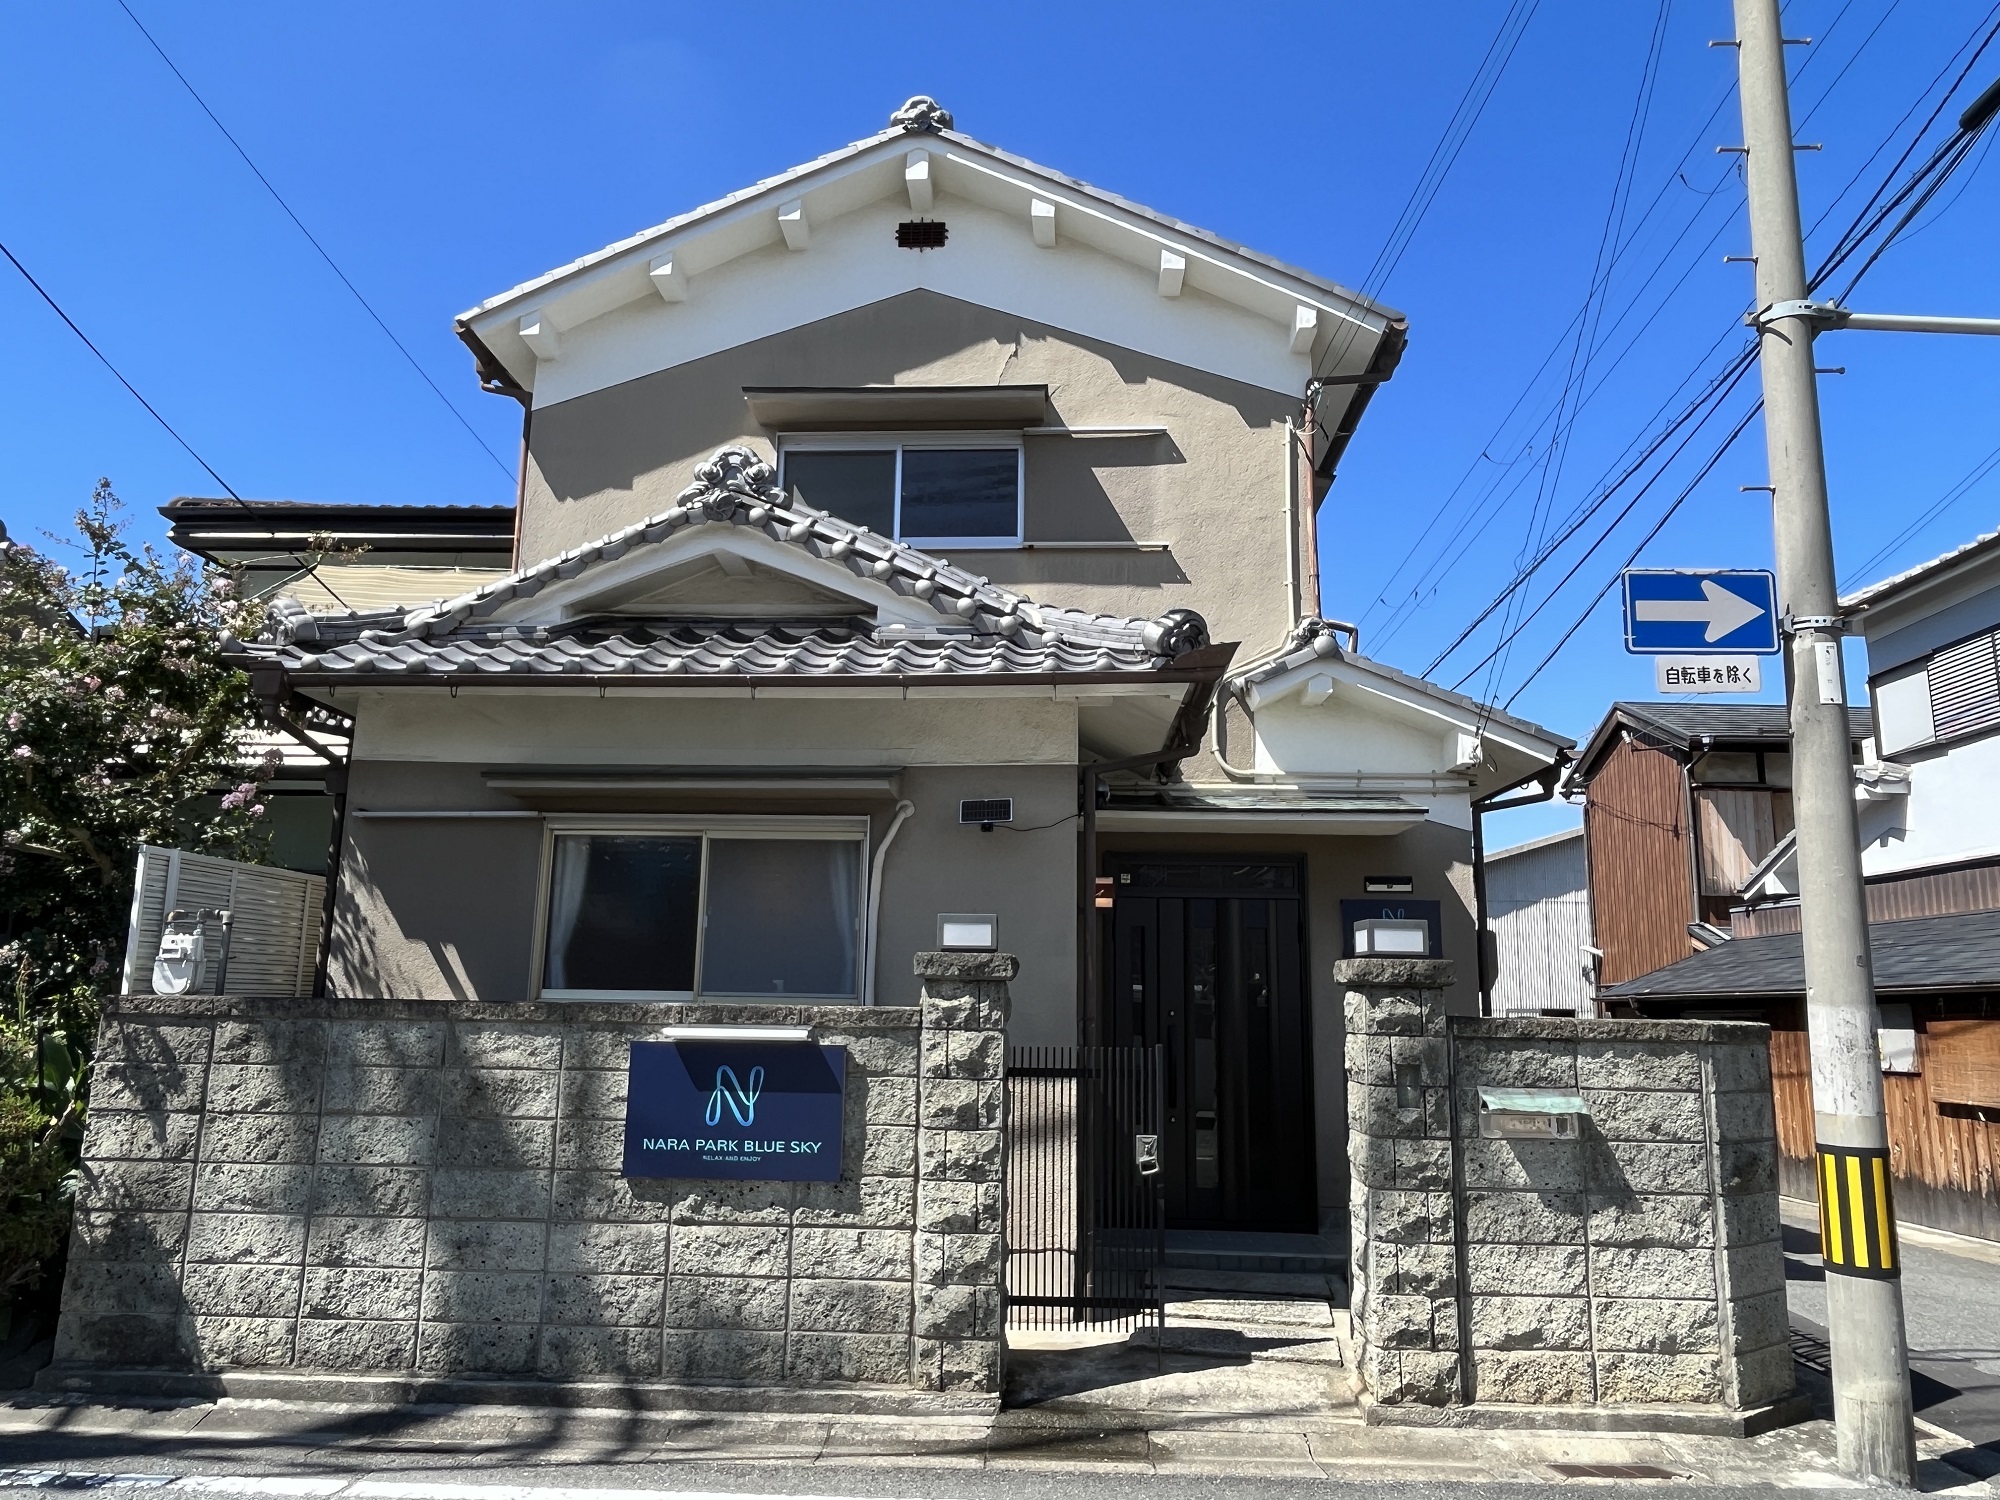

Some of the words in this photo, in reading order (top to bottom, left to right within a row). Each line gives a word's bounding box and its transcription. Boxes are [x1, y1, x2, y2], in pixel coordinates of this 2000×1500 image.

[1666, 665, 1752, 685] 自転車を除く
[643, 1138, 690, 1151] NARA
[695, 1139, 739, 1152] PARK
[744, 1140, 786, 1153] BLUE
[790, 1141, 822, 1154] SKY
